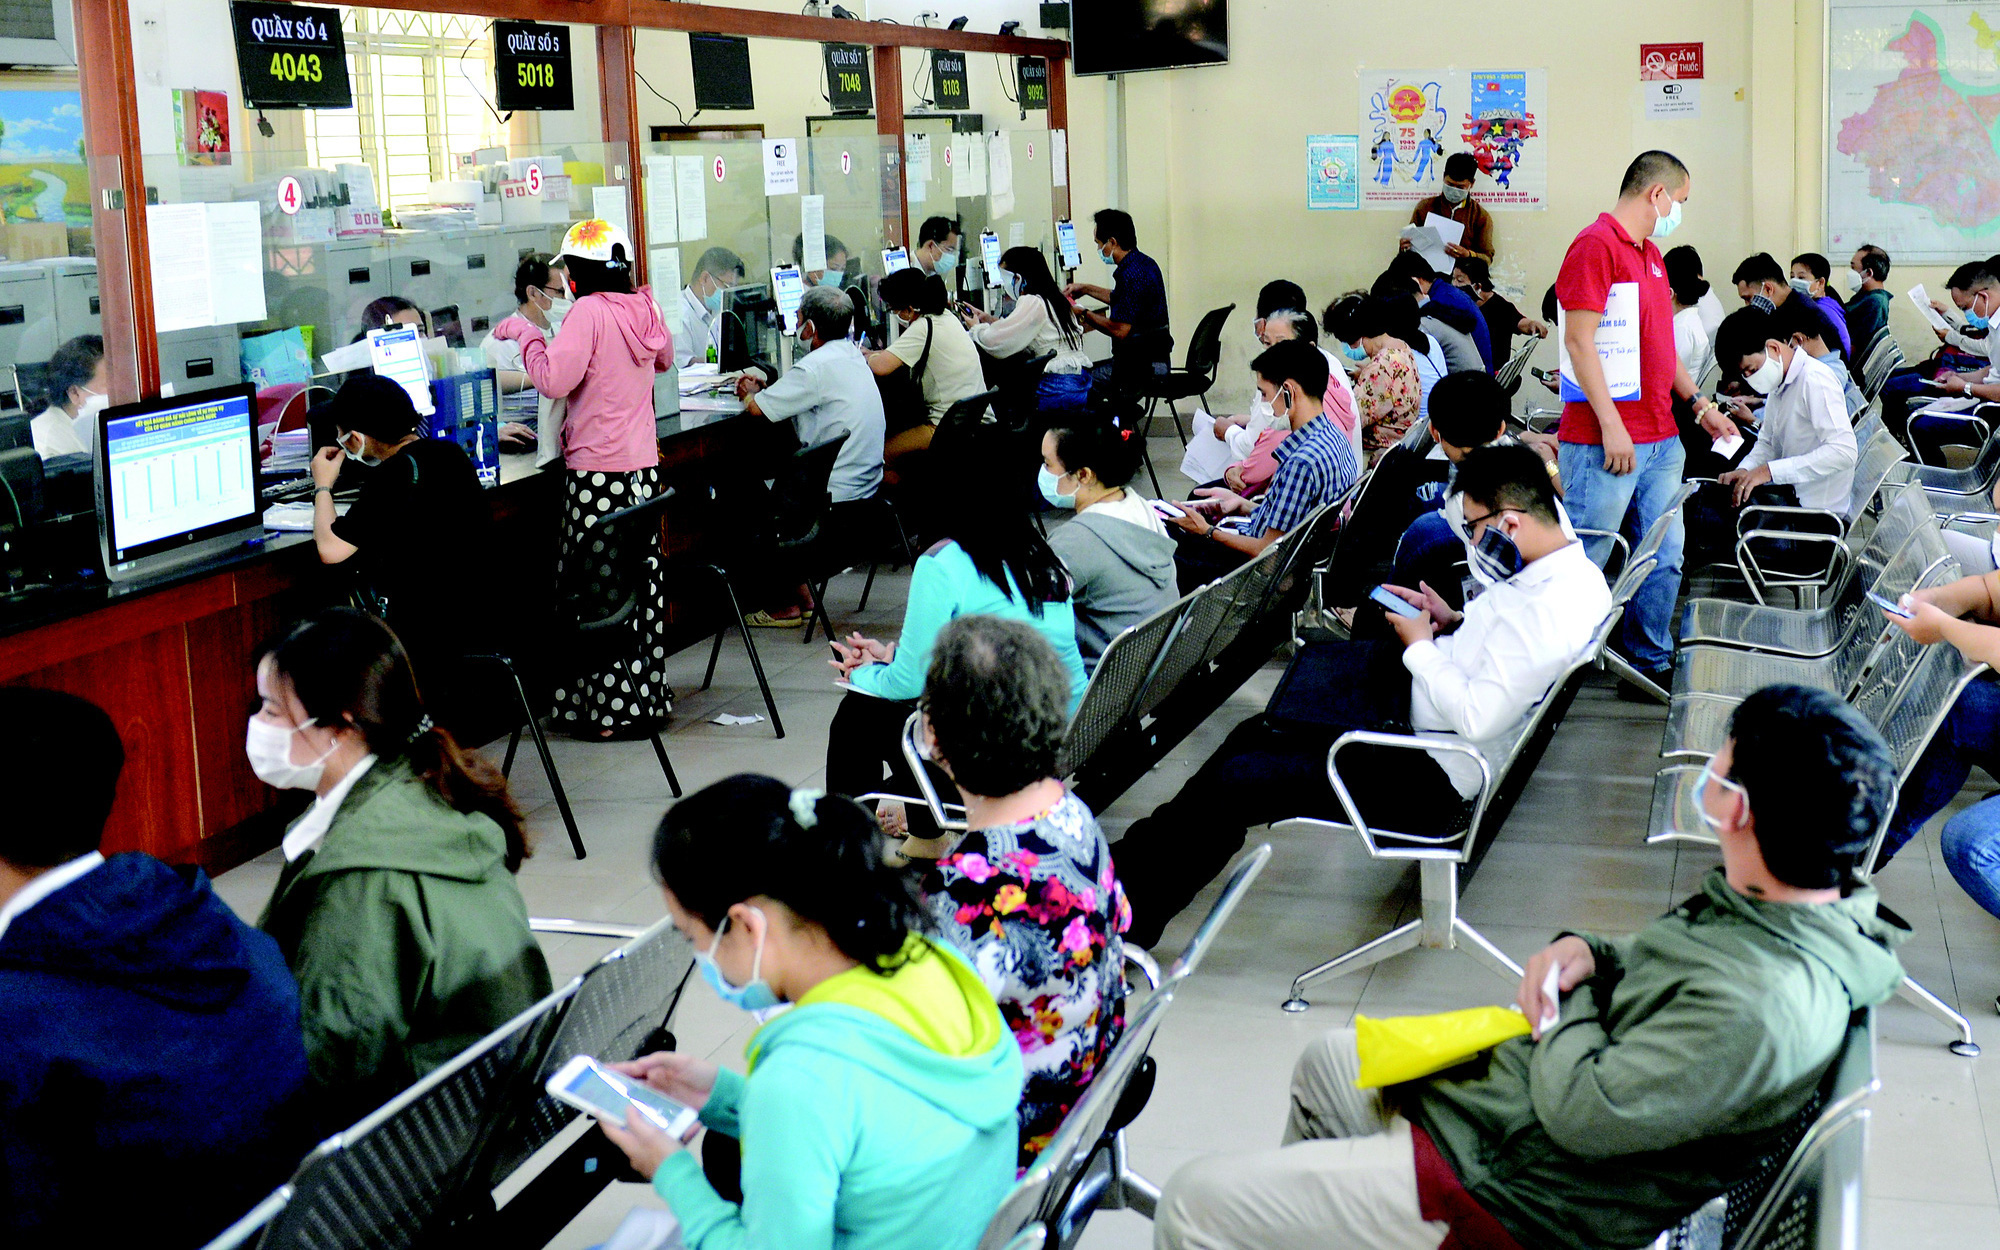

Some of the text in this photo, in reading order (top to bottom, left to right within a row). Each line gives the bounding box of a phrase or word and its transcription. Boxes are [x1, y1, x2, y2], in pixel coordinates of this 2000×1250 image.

[251, 13, 328, 42] QUẦY SỐ 4
[507, 30, 560, 54] QUẦY SỐ 5
[831, 48, 862, 67] QUẦY SỐ 7
[1670, 49, 1696, 61] CẤM
[270, 52, 323, 82] 4043
[518, 62, 554, 87] 5018
[1680, 63, 1699, 72] THUỐC
[839, 73, 861, 92] 7048
[943, 79, 960, 96] 8103
[1027, 85, 1044, 100] 9092
[1399, 128, 1416, 137] 75
[946, 149, 951, 164] 8
[1029, 144, 1033, 158] 9
[716, 160, 723, 178] 6
[843, 155, 848, 171] 7
[531, 169, 539, 190] 5
[285, 183, 296, 207] 4
